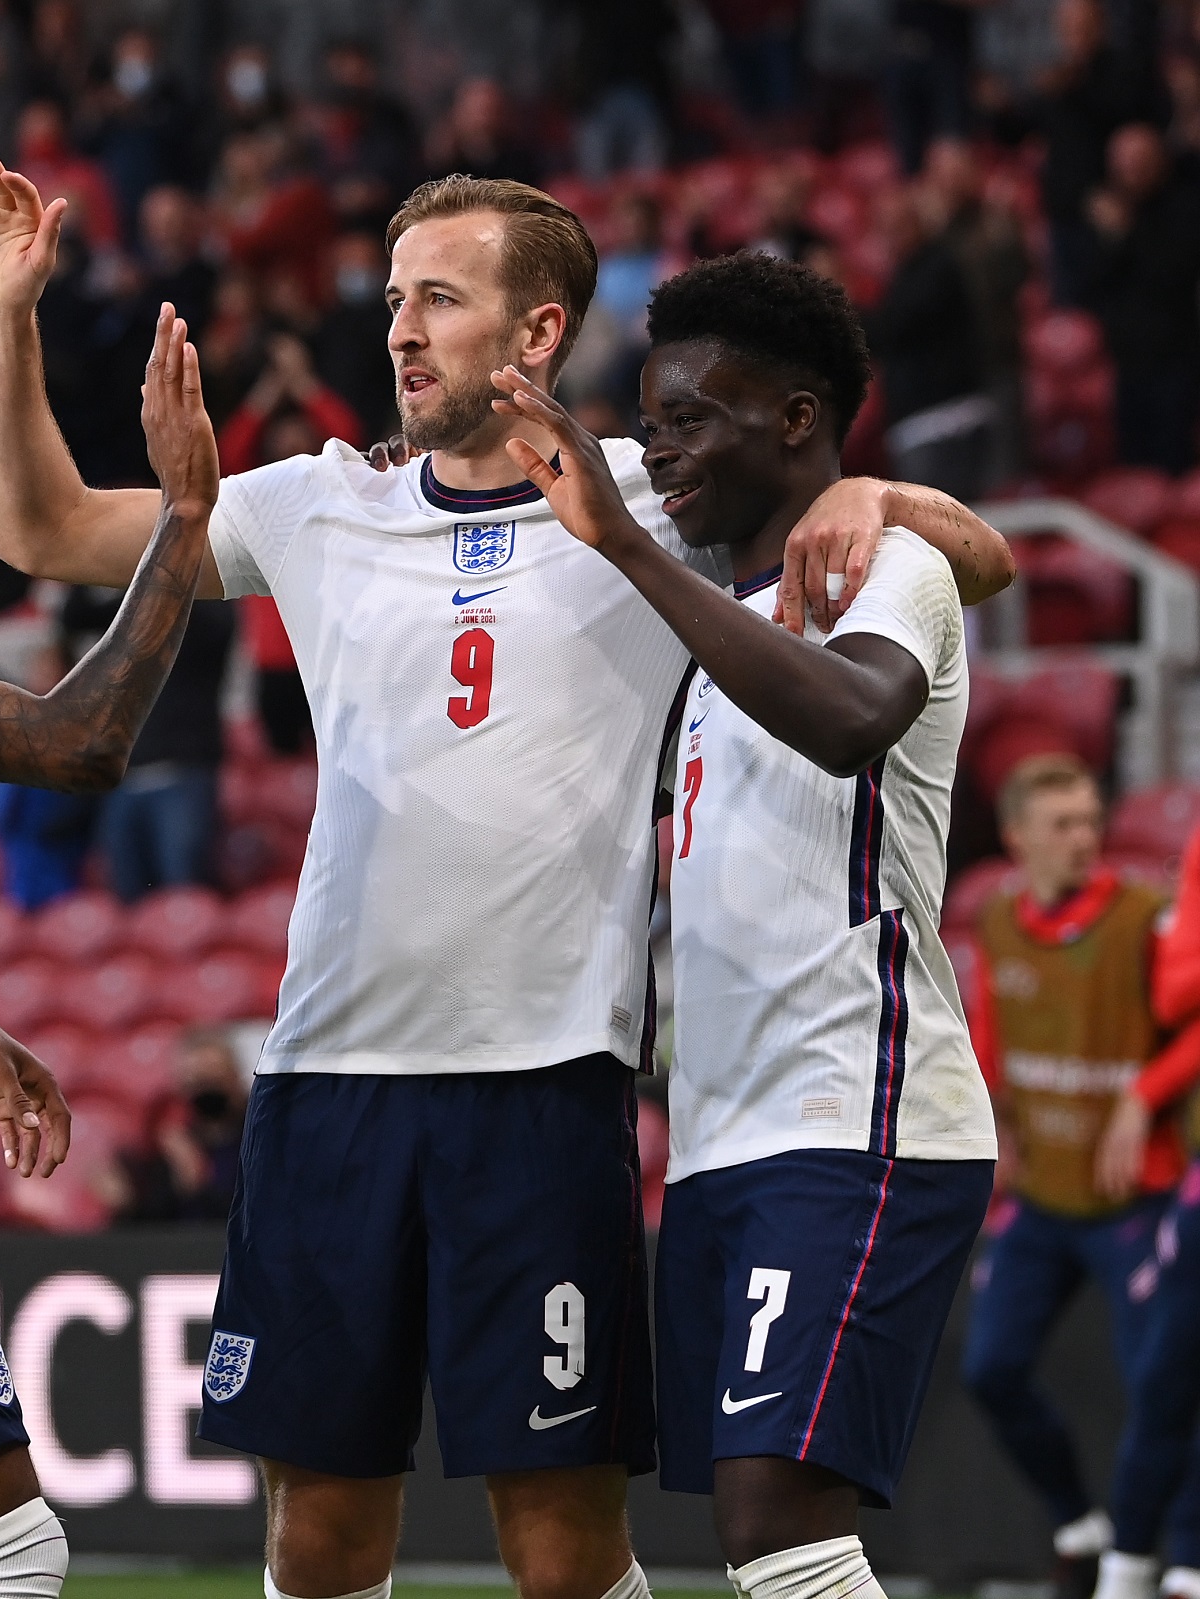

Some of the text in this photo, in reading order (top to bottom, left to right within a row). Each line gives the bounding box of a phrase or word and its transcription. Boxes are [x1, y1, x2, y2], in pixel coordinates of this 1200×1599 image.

[454, 615, 496, 624] 2 JUNE 2021
[446, 627, 495, 730] 9
[678, 755, 703, 860] 7
[543, 1281, 586, 1391] 9
[746, 1267, 789, 1373] 7
